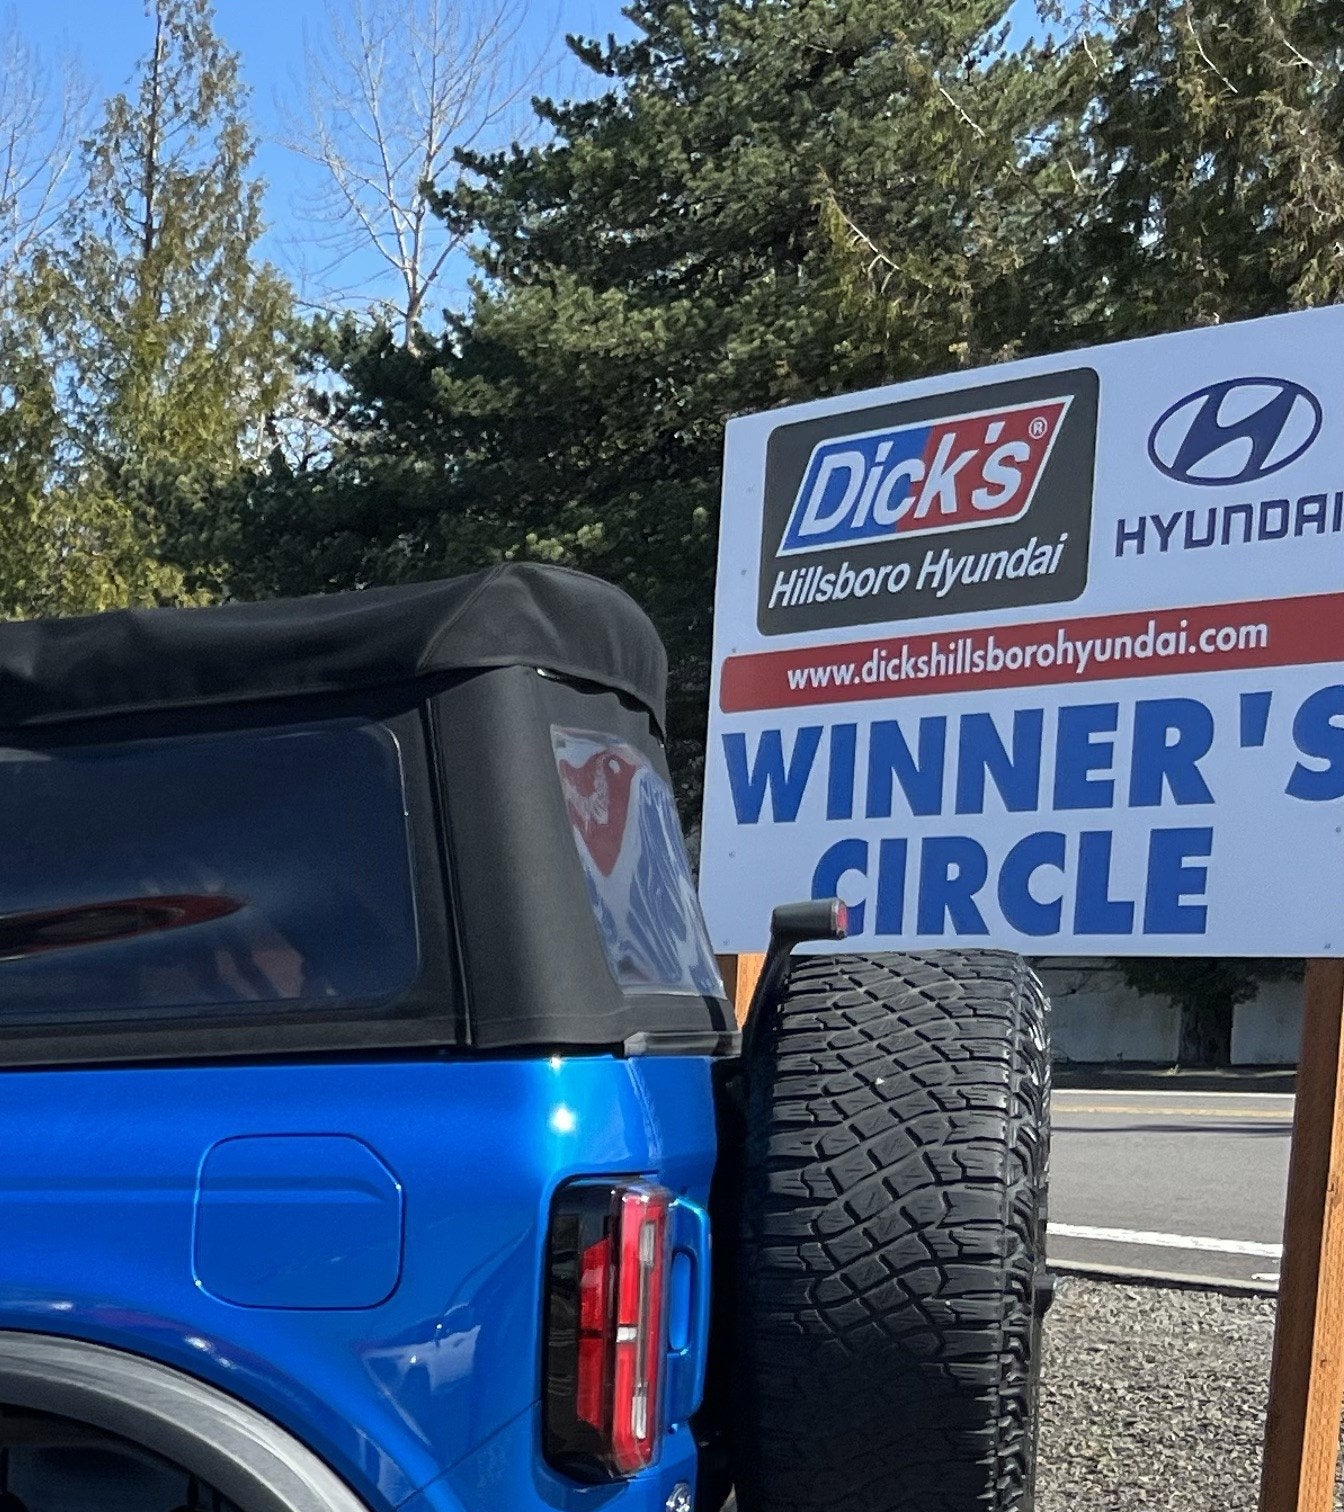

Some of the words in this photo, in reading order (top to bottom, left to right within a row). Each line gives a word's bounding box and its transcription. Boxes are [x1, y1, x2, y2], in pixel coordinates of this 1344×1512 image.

[1115, 491, 1344, 558] HYUNDAI
[768, 561, 911, 609] Hillsboro
[915, 532, 1069, 598] Hyundai
[786, 619, 1269, 691] www.dickshillsborohyundai.com
[721, 684, 1344, 825] WINNER'S
[811, 826, 1214, 937] CIRCLE
